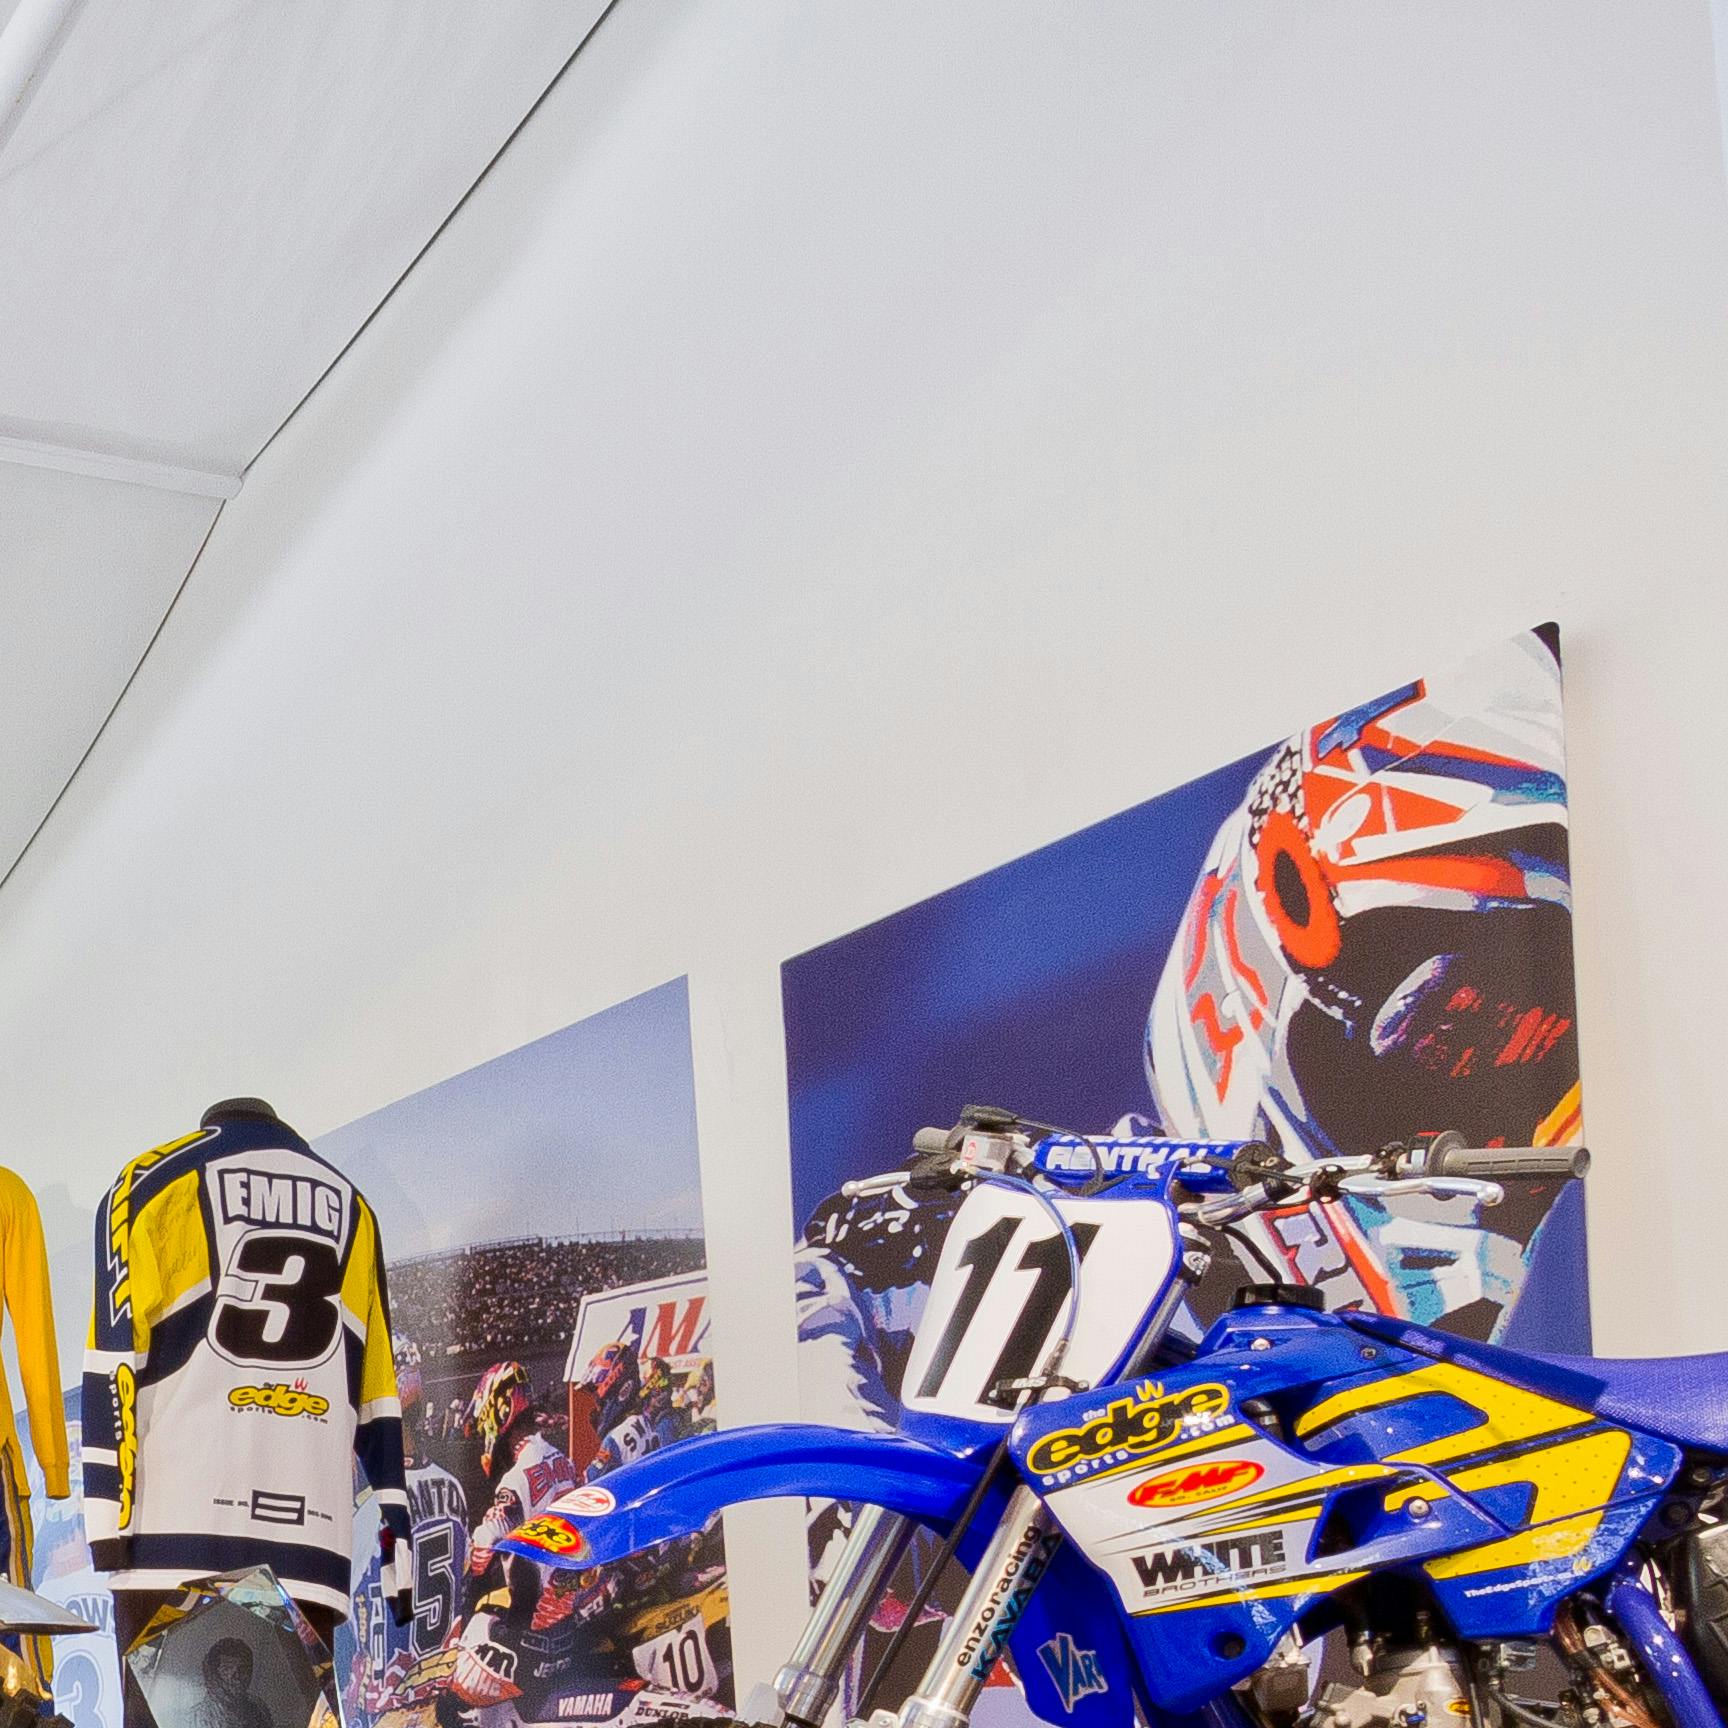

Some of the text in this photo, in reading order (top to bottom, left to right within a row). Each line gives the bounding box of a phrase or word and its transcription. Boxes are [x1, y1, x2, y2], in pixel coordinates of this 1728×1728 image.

[219, 1168, 342, 1243] EMIG
[209, 1230, 342, 1369] 3
[617, 1297, 711, 1360] AM
[915, 1215, 1105, 1405] 11
[228, 1384, 330, 1417] edge
[1026, 1382, 1230, 1475] edge
[1043, 1414, 1236, 1487] sports .com
[1129, 1464, 1264, 1506] FMF
[411, 1524, 454, 1658] 5
[1130, 1530, 1286, 1588] WHITE
[1142, 1564, 1287, 1598] BROTHERS
[662, 1629, 706, 1694] 10
[558, 1693, 614, 1717] YAMAHA
